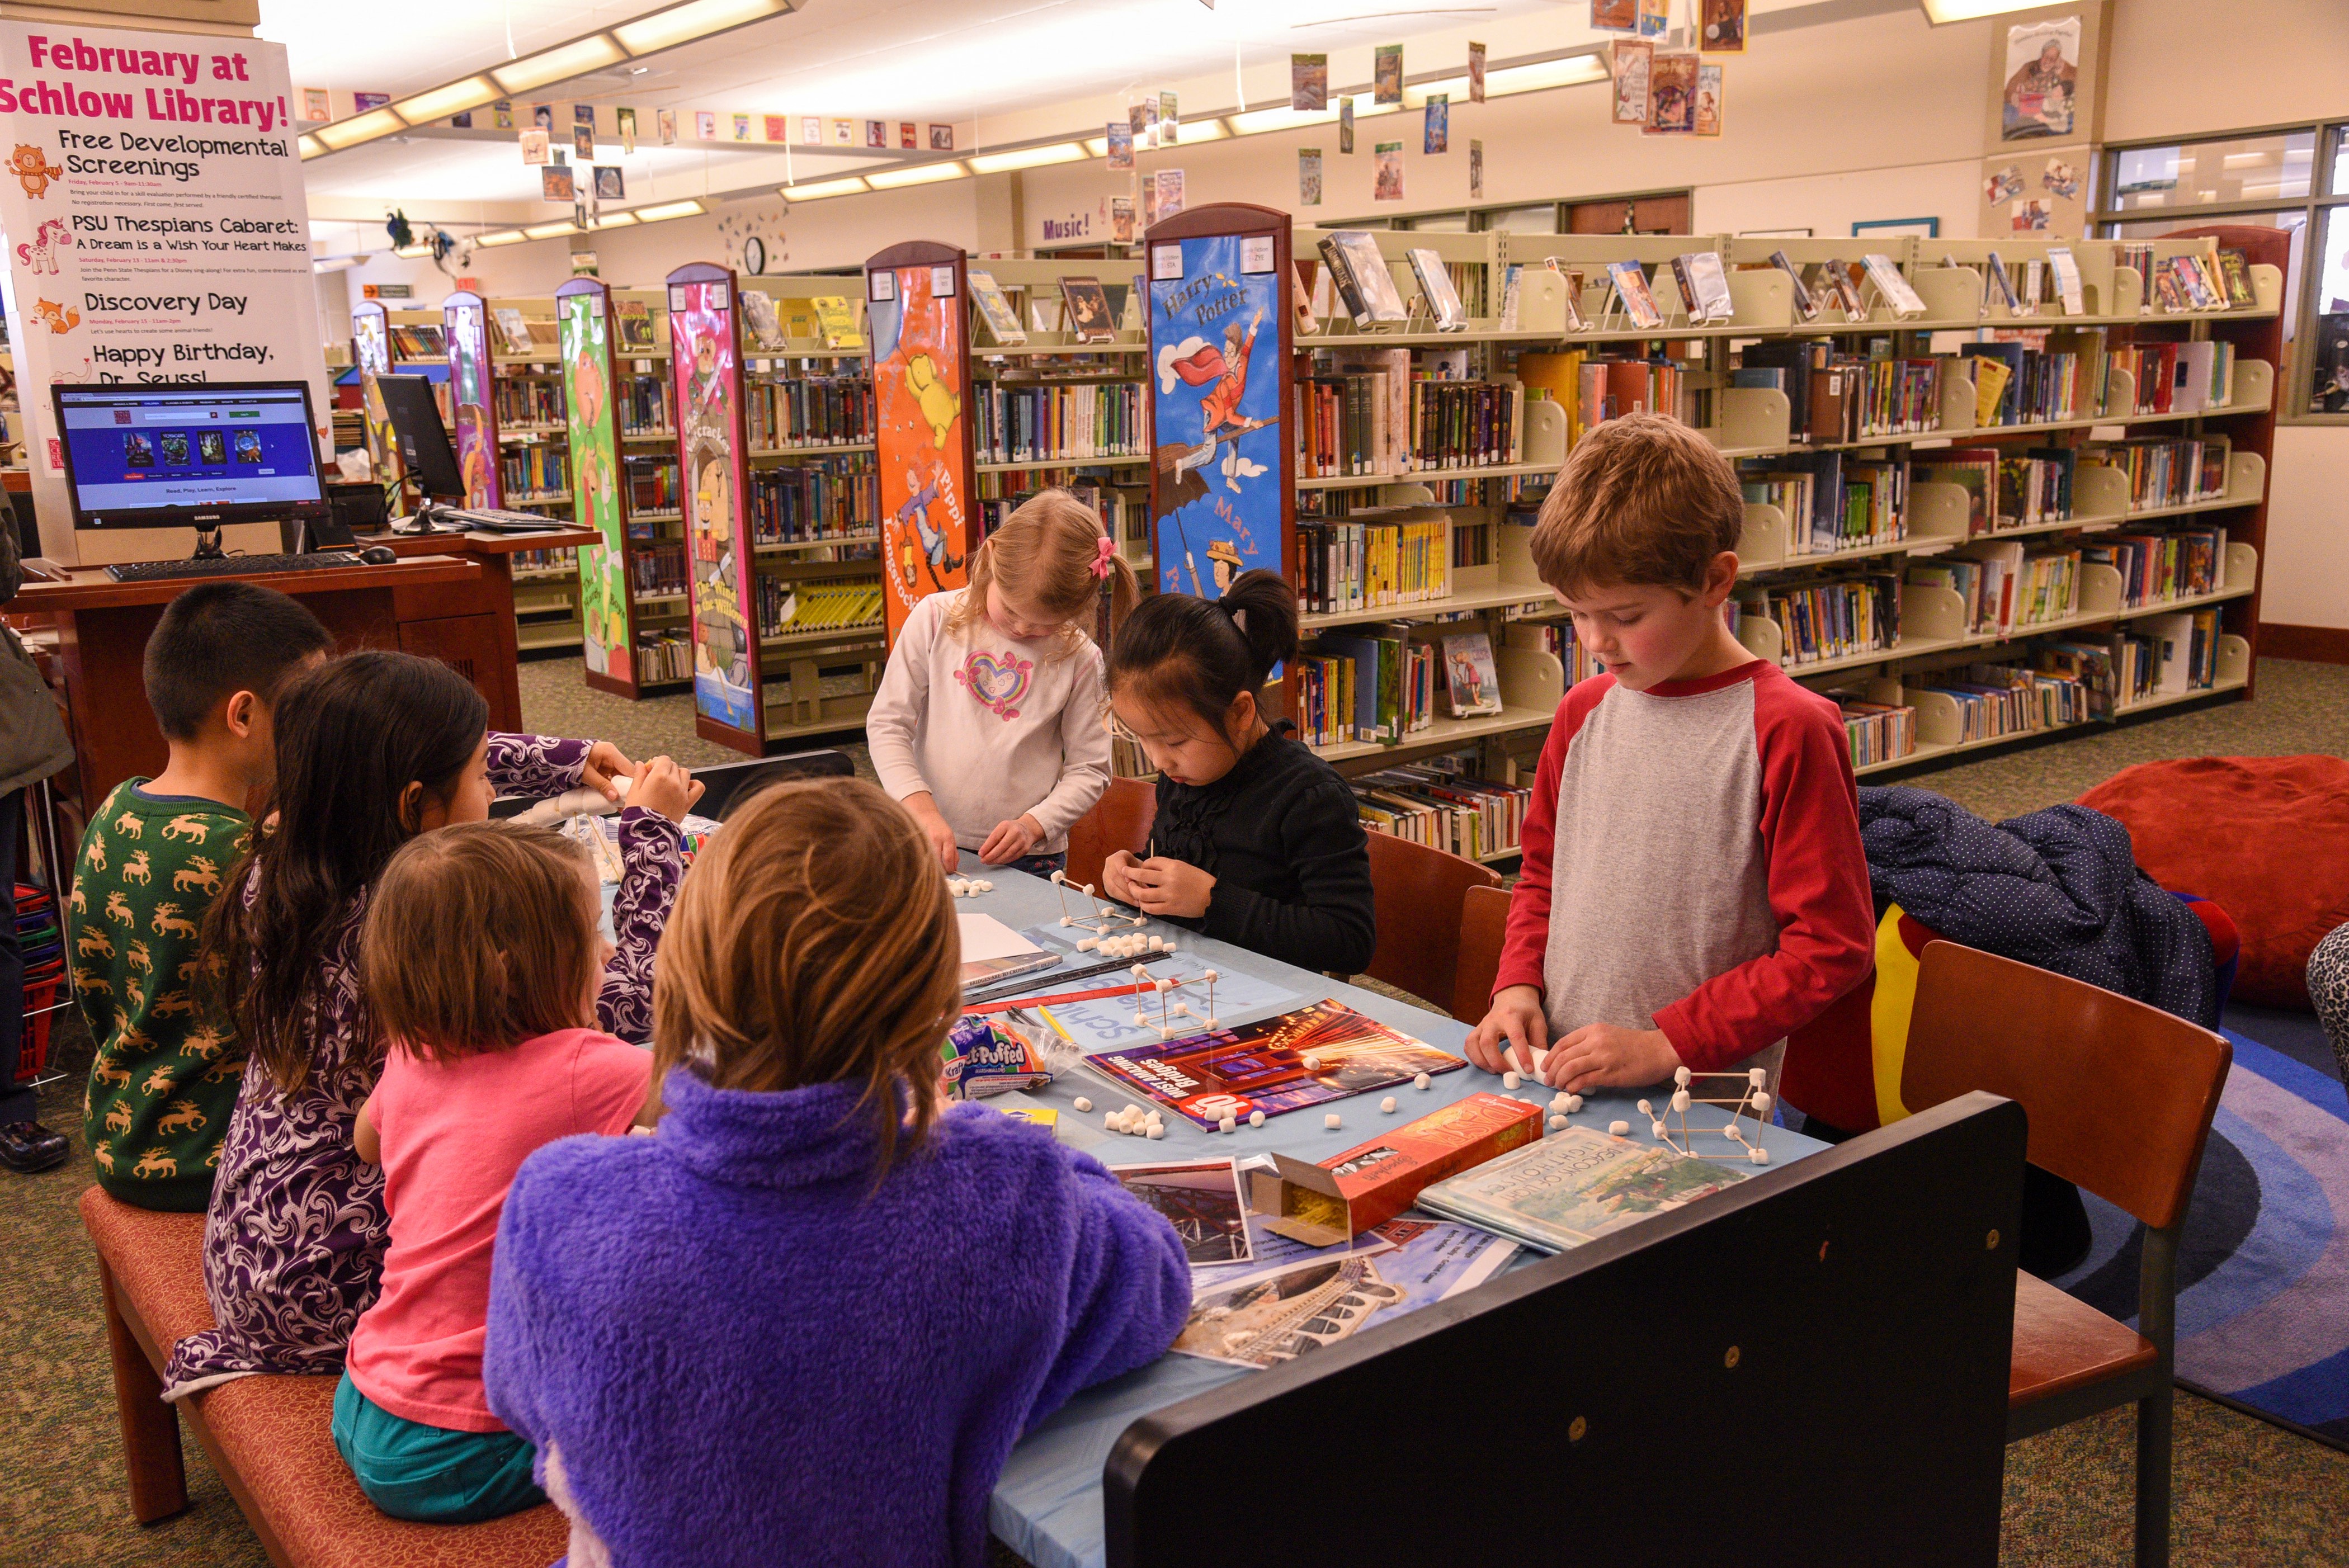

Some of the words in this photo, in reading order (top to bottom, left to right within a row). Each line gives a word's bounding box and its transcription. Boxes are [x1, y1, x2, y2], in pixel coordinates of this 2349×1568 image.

[27, 35, 199, 84] February
[211, 52, 249, 81] at
[0, 78, 134, 119] Schlow
[145, 87, 289, 133] Library!
[58, 130, 112, 152] Free
[120, 131, 289, 159] Developmental
[66, 155, 200, 182] Screenings
[72, 215, 107, 232] PSU
[117, 216, 213, 236] Thespians
[220, 217, 299, 234] Cabaret:
[1044, 213, 1089, 240] Music!
[77, 239, 86, 249] A
[90, 239, 133, 250] Dream
[136, 240, 148, 250] is
[153, 242, 162, 250] a
[166, 239, 197, 251] Wish
[202, 240, 229, 251] Your
[234, 240, 269, 251] Heart
[272, 241, 306, 252] Makes
[84, 292, 201, 316] Discovery
[207, 292, 248, 315] Day
[1162, 274, 1213, 321] Harry
[1195, 288, 1248, 328] Potter
[93, 344, 165, 367] Happy
[173, 343, 274, 365] Birthday,
[100, 371, 124, 384] Dr
[940, 470, 966, 528] Pippi
[1214, 495, 1259, 555] Mary
[969, 977, 990, 986] BRIDGES
[1009, 967, 1025, 975] CROSS
[1363, 1023, 1405, 1043] SCHOLASTIC
[1107, 1055, 1157, 1083] AMAZING
[1149, 1077, 1191, 1099] MOST
[1139, 1058, 1200, 1088] Bridges
[1186, 1104, 1206, 1115] THE
[1478, 1097, 1526, 1114] Wegmans
[1478, 1141, 1602, 1196] LIGHTHOUSES
[1499, 1185, 1541, 1202] LIGHT
[1537, 1174, 1562, 1187] OF
[1558, 1147, 1623, 1177] BEACONS
